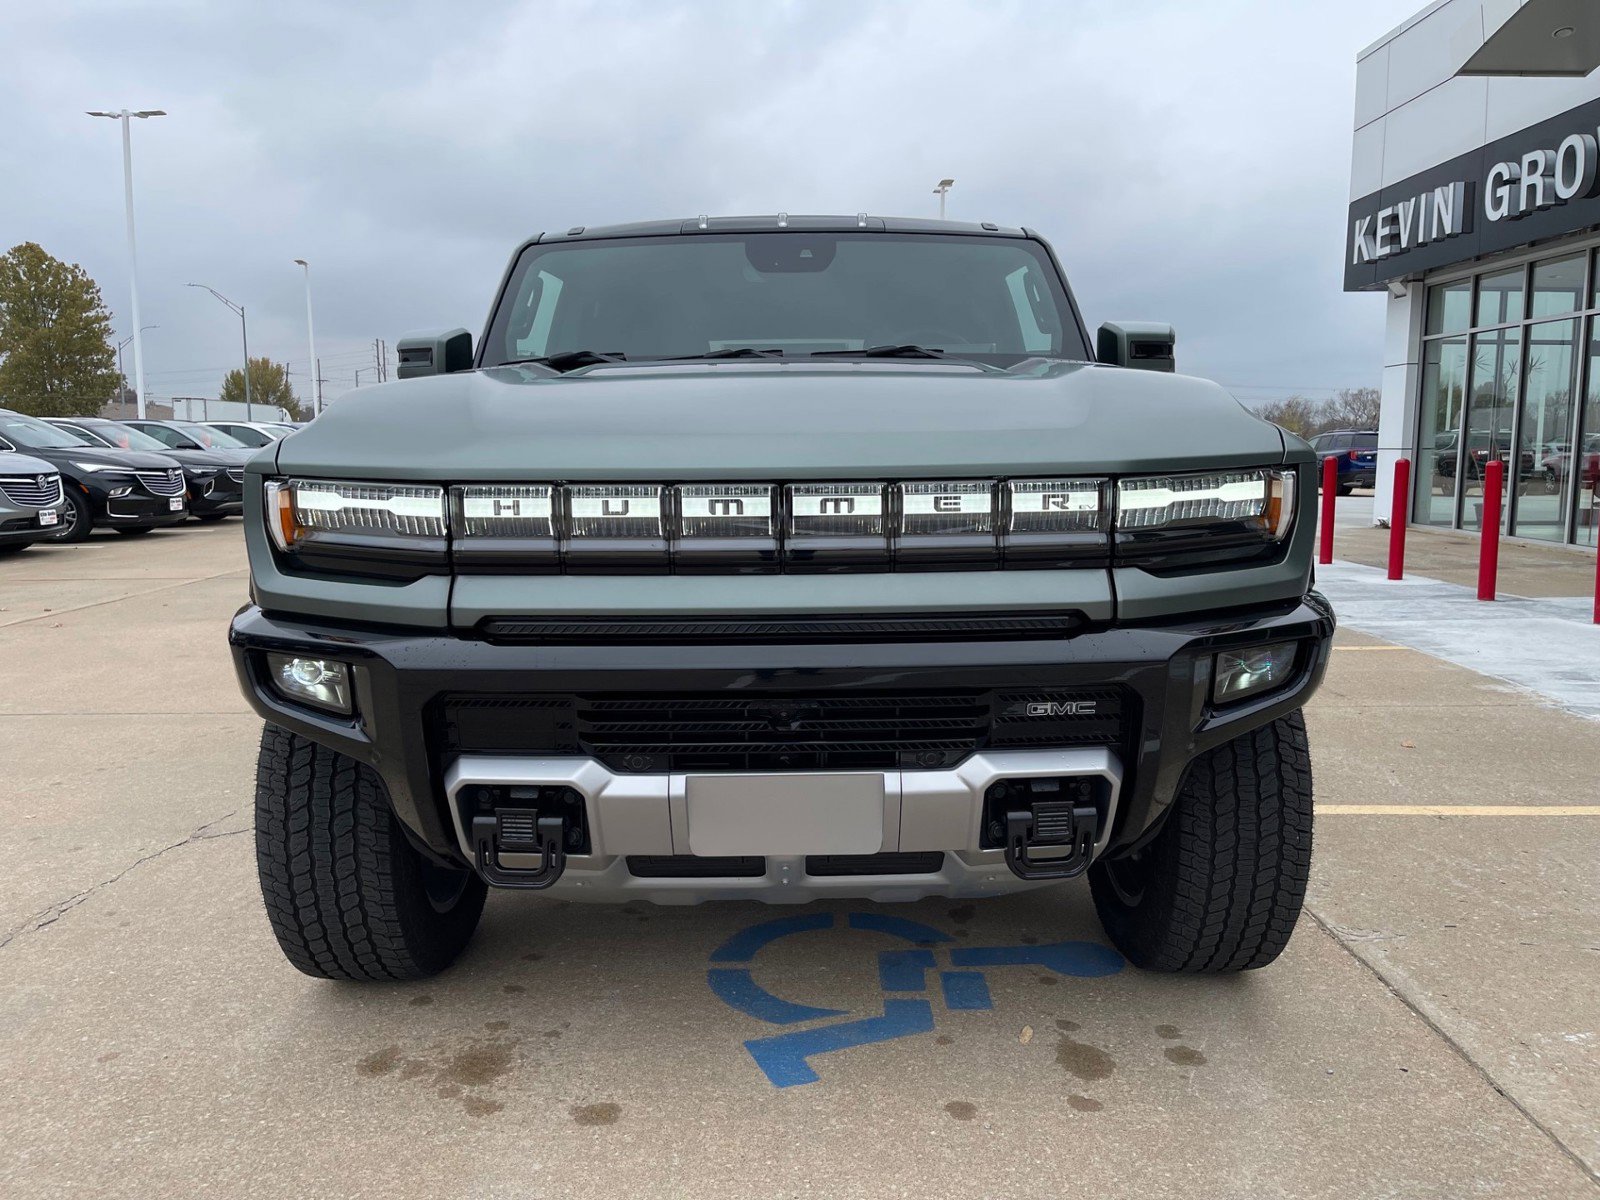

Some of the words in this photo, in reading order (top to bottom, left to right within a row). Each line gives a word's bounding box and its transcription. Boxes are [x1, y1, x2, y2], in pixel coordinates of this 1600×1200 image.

[1353, 181, 1470, 265] KEVIN
[1485, 126, 1600, 222] GRO
[493, 493, 1070, 516] HUMMER
[1026, 701, 1097, 717] GMC
